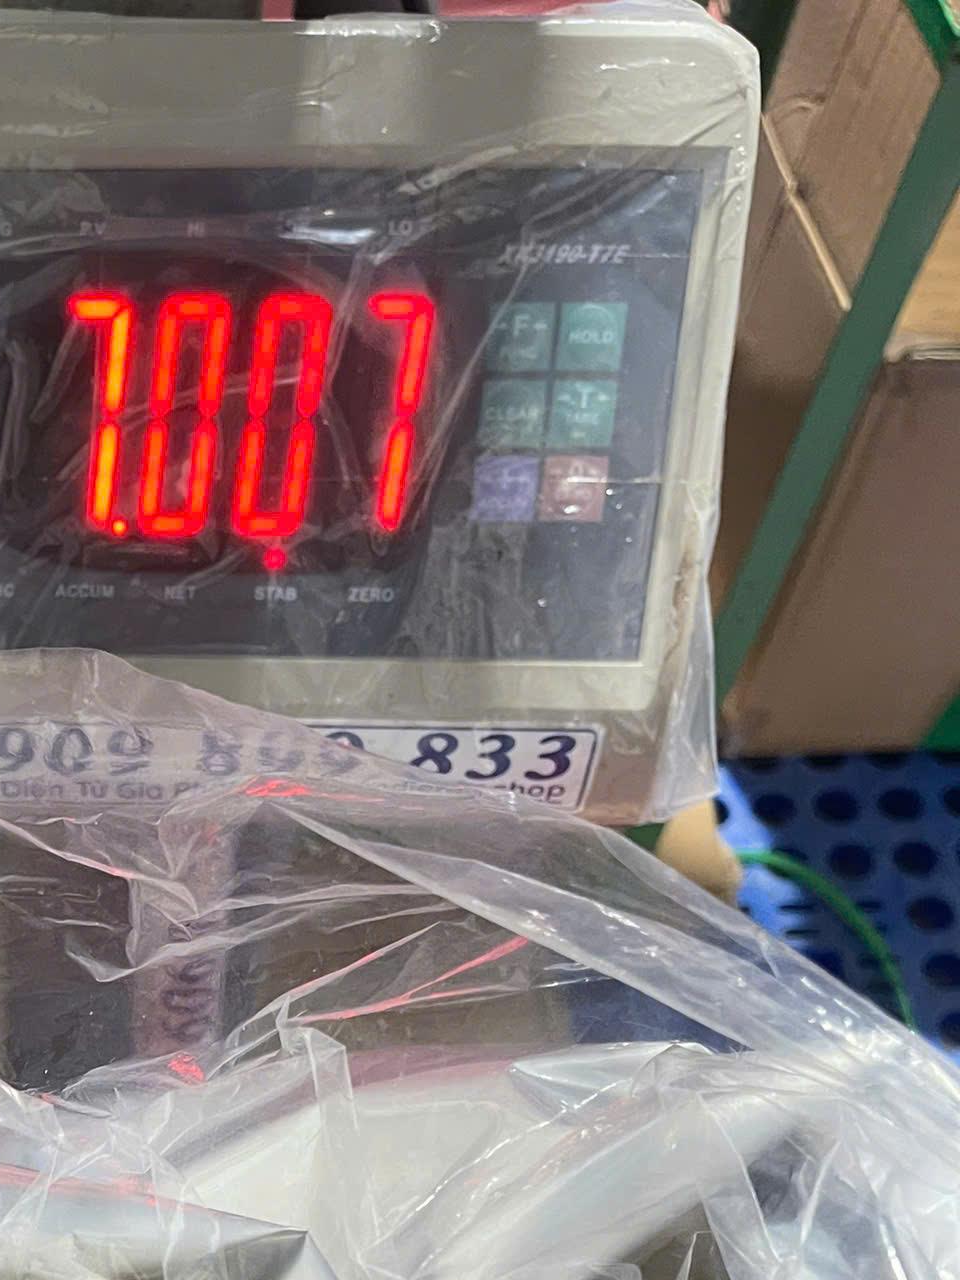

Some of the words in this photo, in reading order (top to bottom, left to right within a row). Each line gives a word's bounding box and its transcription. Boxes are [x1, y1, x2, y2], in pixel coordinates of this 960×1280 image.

[568, 329, 616, 344] HOLD
[55, 584, 115, 598] ACCUM
[164, 585, 196, 600] NET
[254, 586, 297, 601] STAB
[348, 586, 394, 601] ZERO
[410, 733, 576, 780] 833
